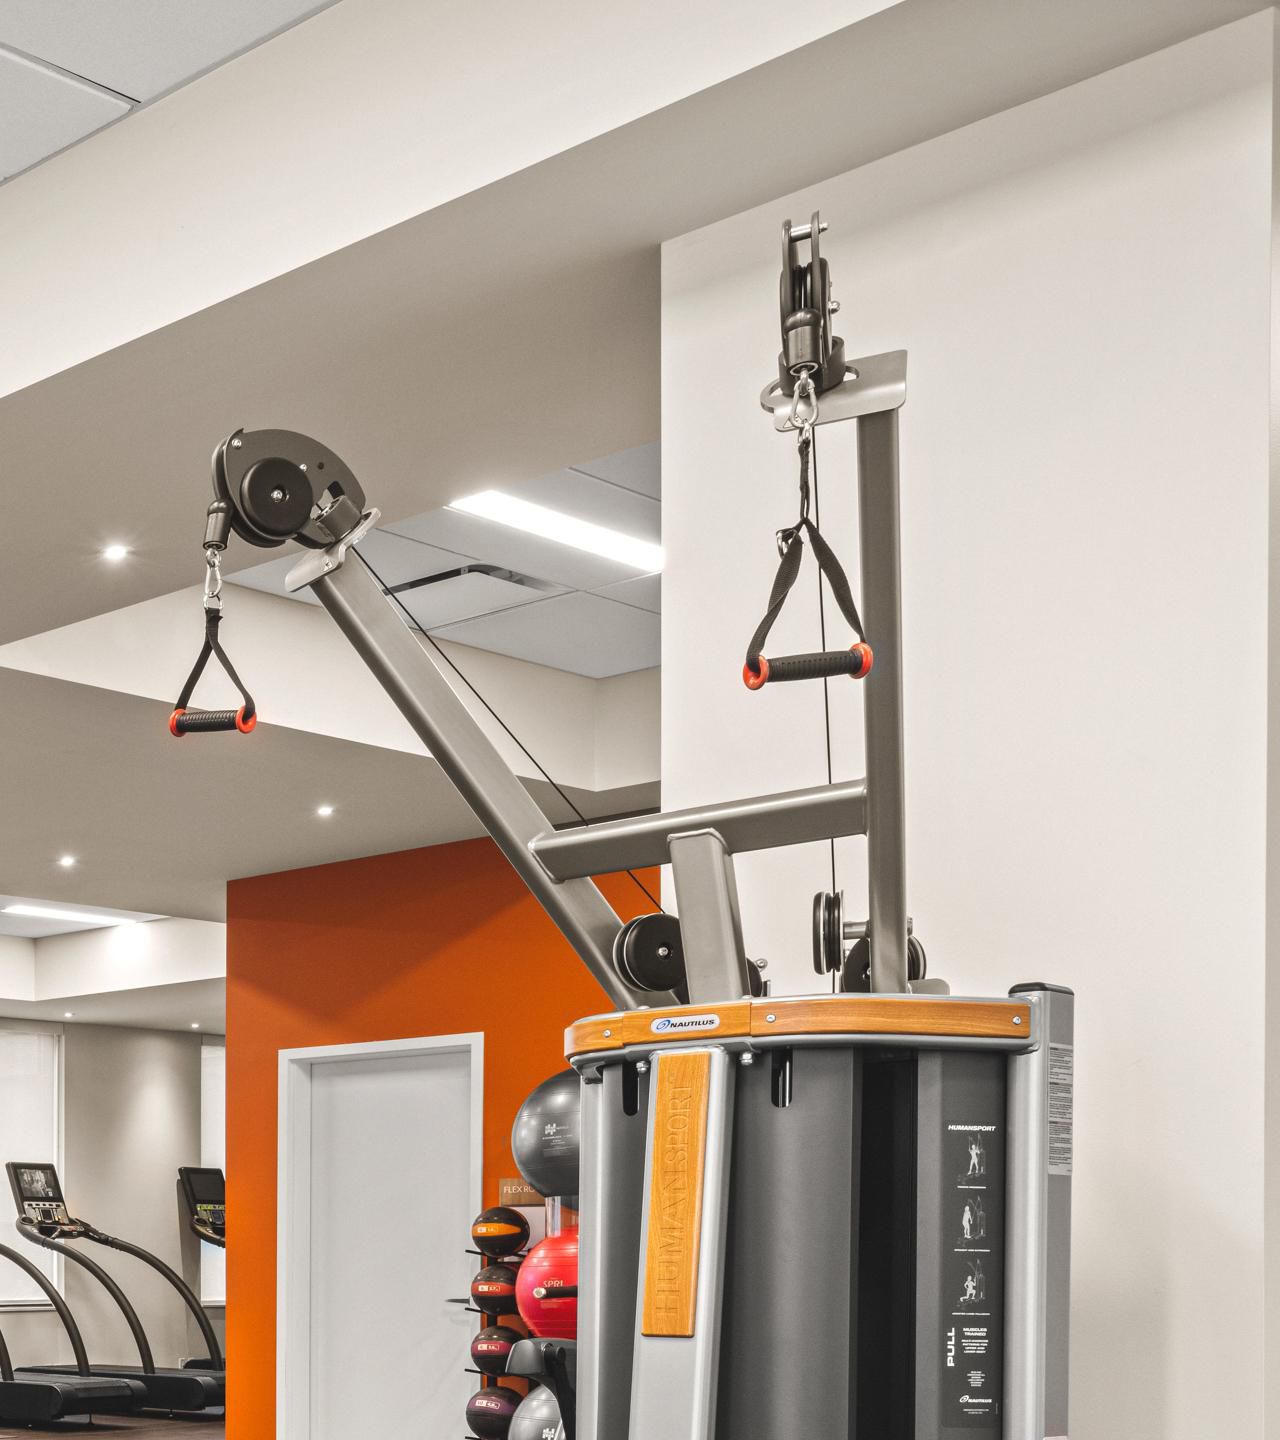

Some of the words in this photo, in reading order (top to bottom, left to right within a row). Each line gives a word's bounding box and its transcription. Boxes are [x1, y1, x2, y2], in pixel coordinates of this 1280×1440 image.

[670, 1019, 715, 1028] NAUTILUS
[503, 1185, 523, 1193] FLEX
[655, 1084, 693, 1317] HUMANSPORT
[947, 1327, 956, 1367] PULL
